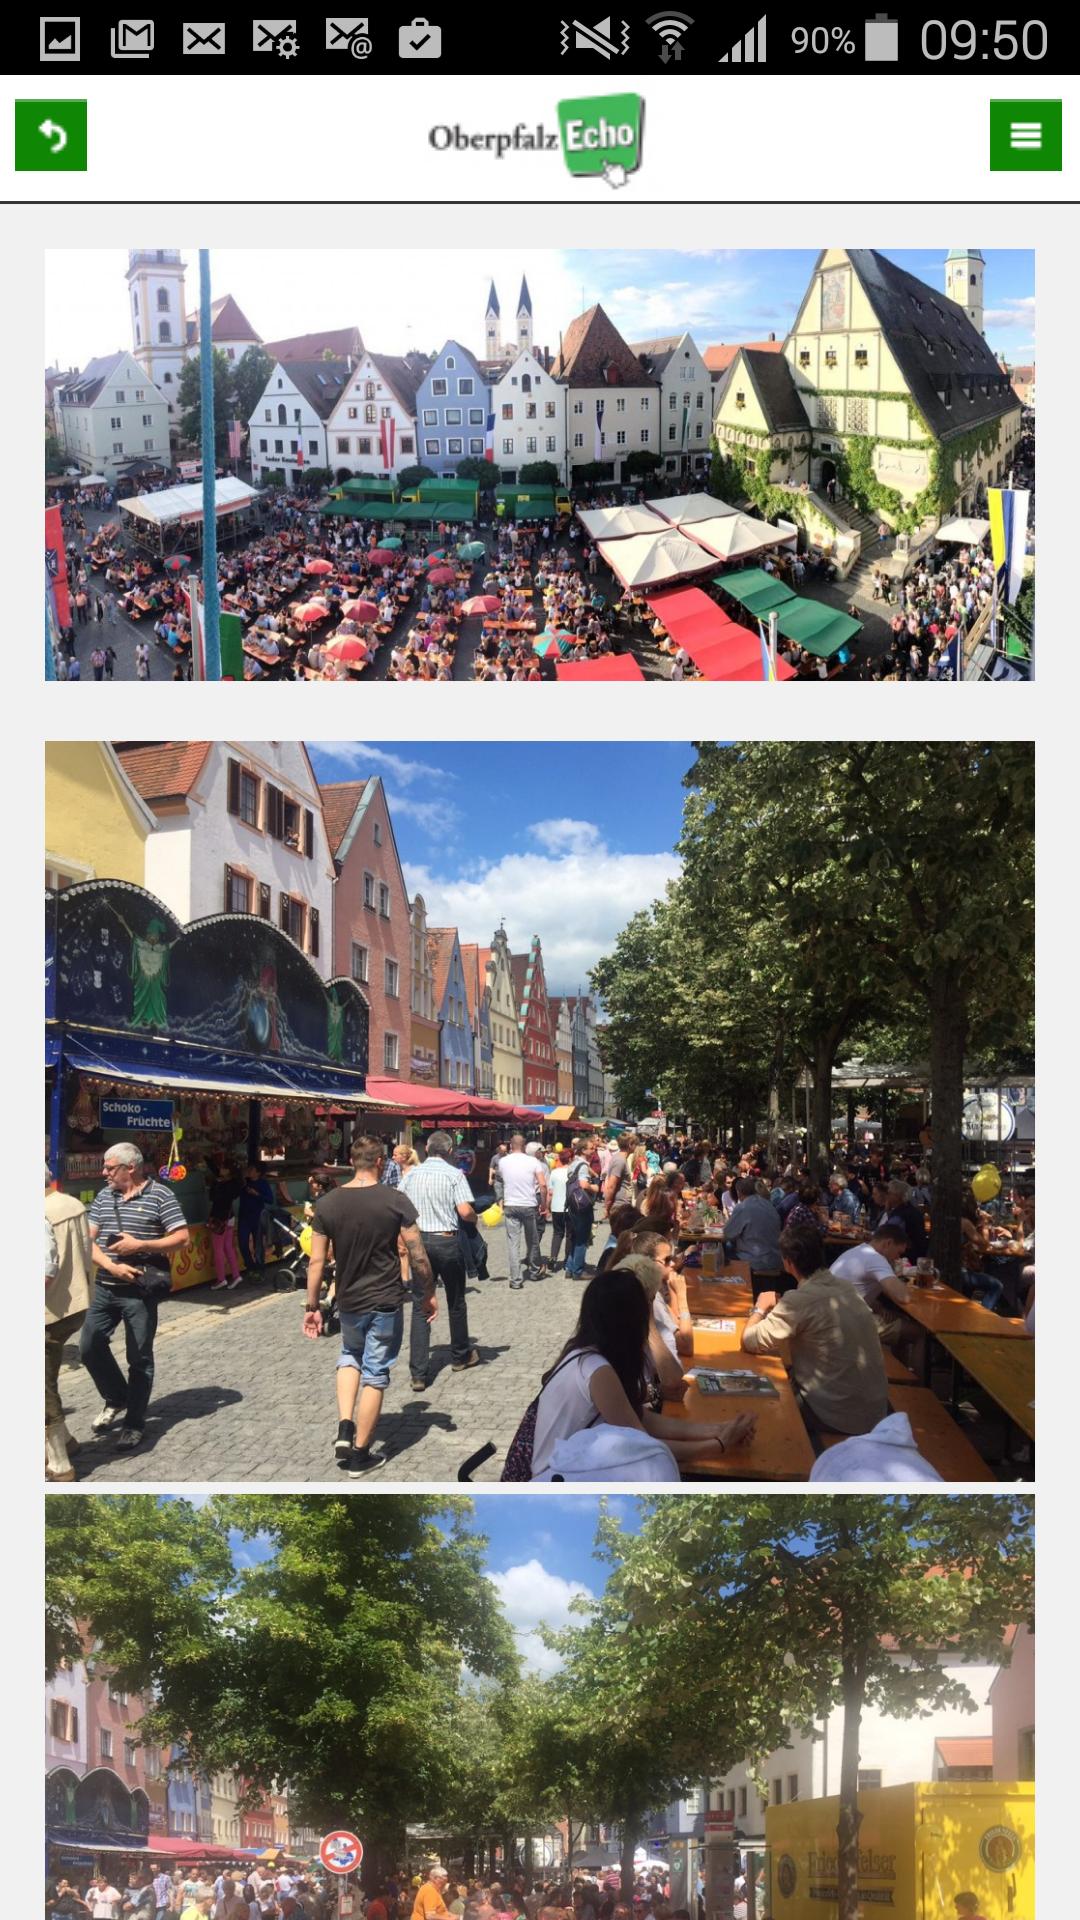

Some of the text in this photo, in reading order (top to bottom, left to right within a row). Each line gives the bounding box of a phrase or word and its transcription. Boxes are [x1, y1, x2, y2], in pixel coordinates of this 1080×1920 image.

[791, 27, 855, 53] 90%
[921, 20, 1047, 60] 09:50
[428, 116, 635, 158] Oberpfalz Echo
[127, 1115, 171, 1127] Früchte
